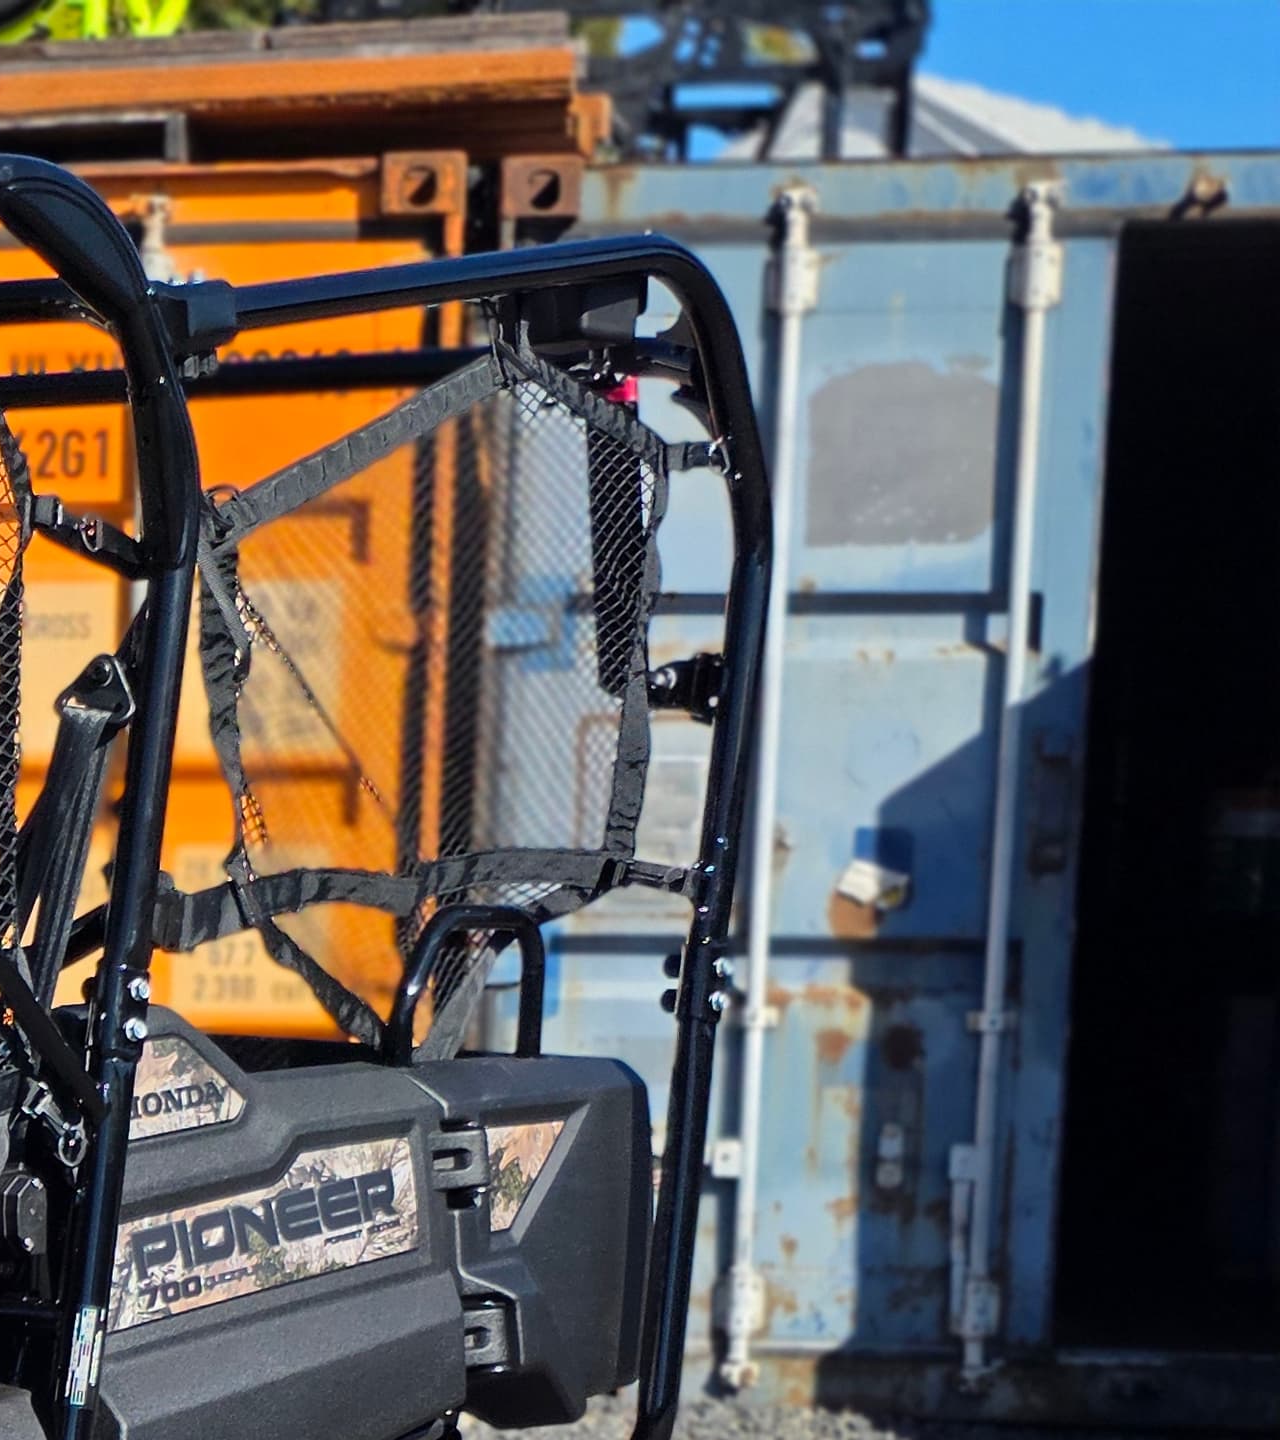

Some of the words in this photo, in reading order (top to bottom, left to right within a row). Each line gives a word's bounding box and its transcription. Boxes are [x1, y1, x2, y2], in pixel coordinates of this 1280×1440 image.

[14, 428, 109, 481] 2G1
[132, 1168, 398, 1280] PIONEER
[138, 1274, 202, 1309] 700
